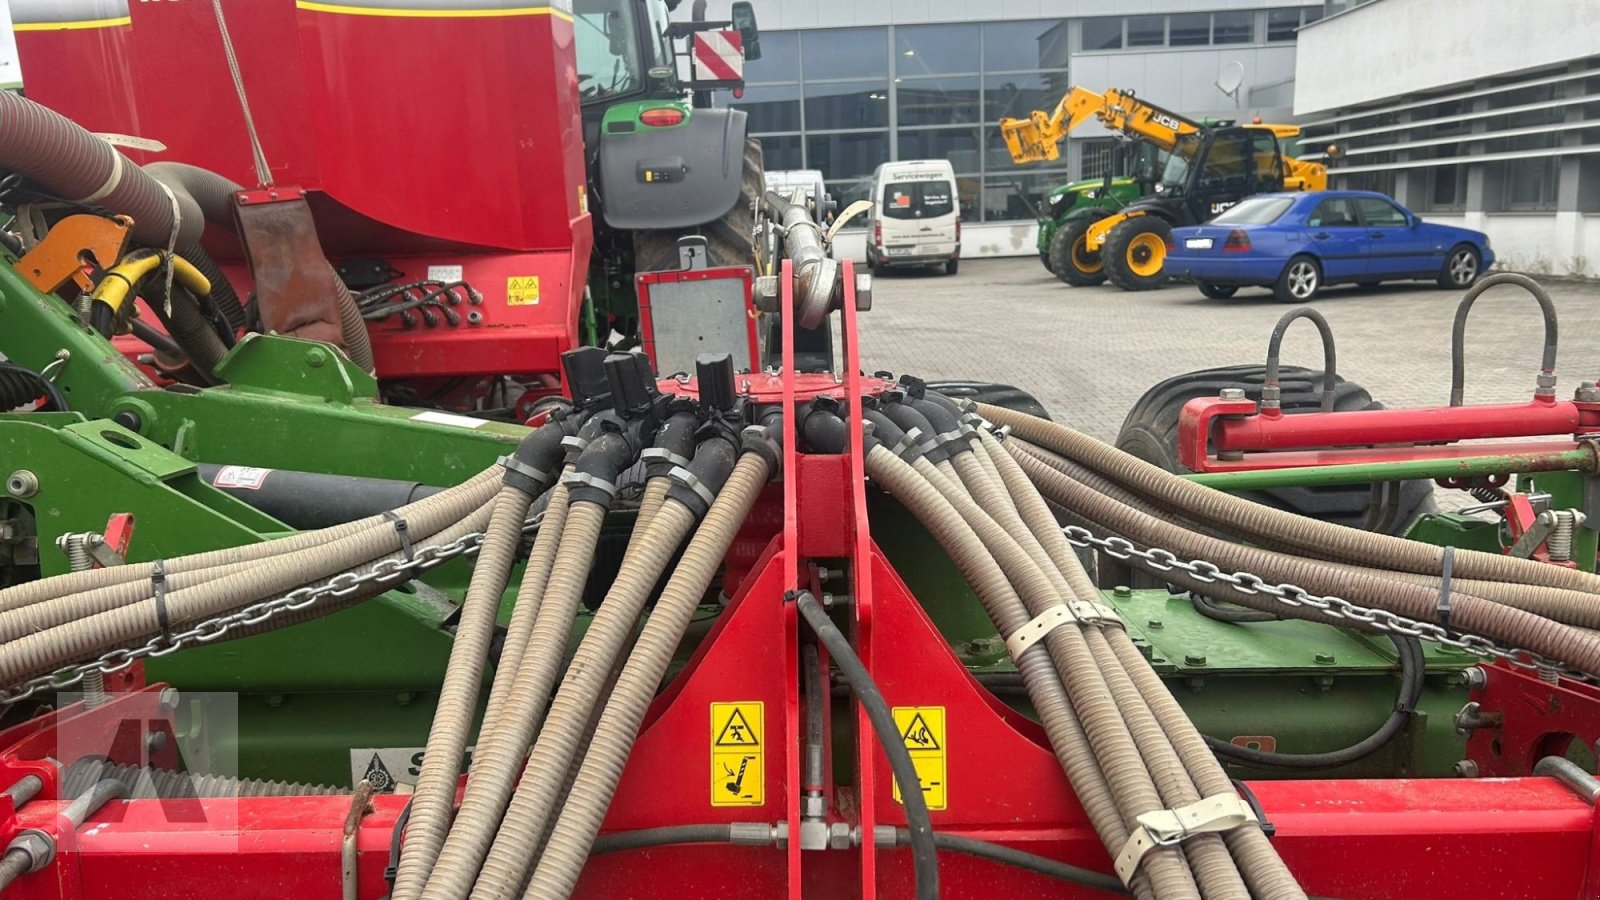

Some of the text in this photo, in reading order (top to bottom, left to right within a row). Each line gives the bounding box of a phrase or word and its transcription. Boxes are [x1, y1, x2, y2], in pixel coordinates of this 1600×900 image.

[1152, 113, 1180, 130] JCB
[892, 172, 944, 180] Servicewagen
[1211, 202, 1236, 213] JC
